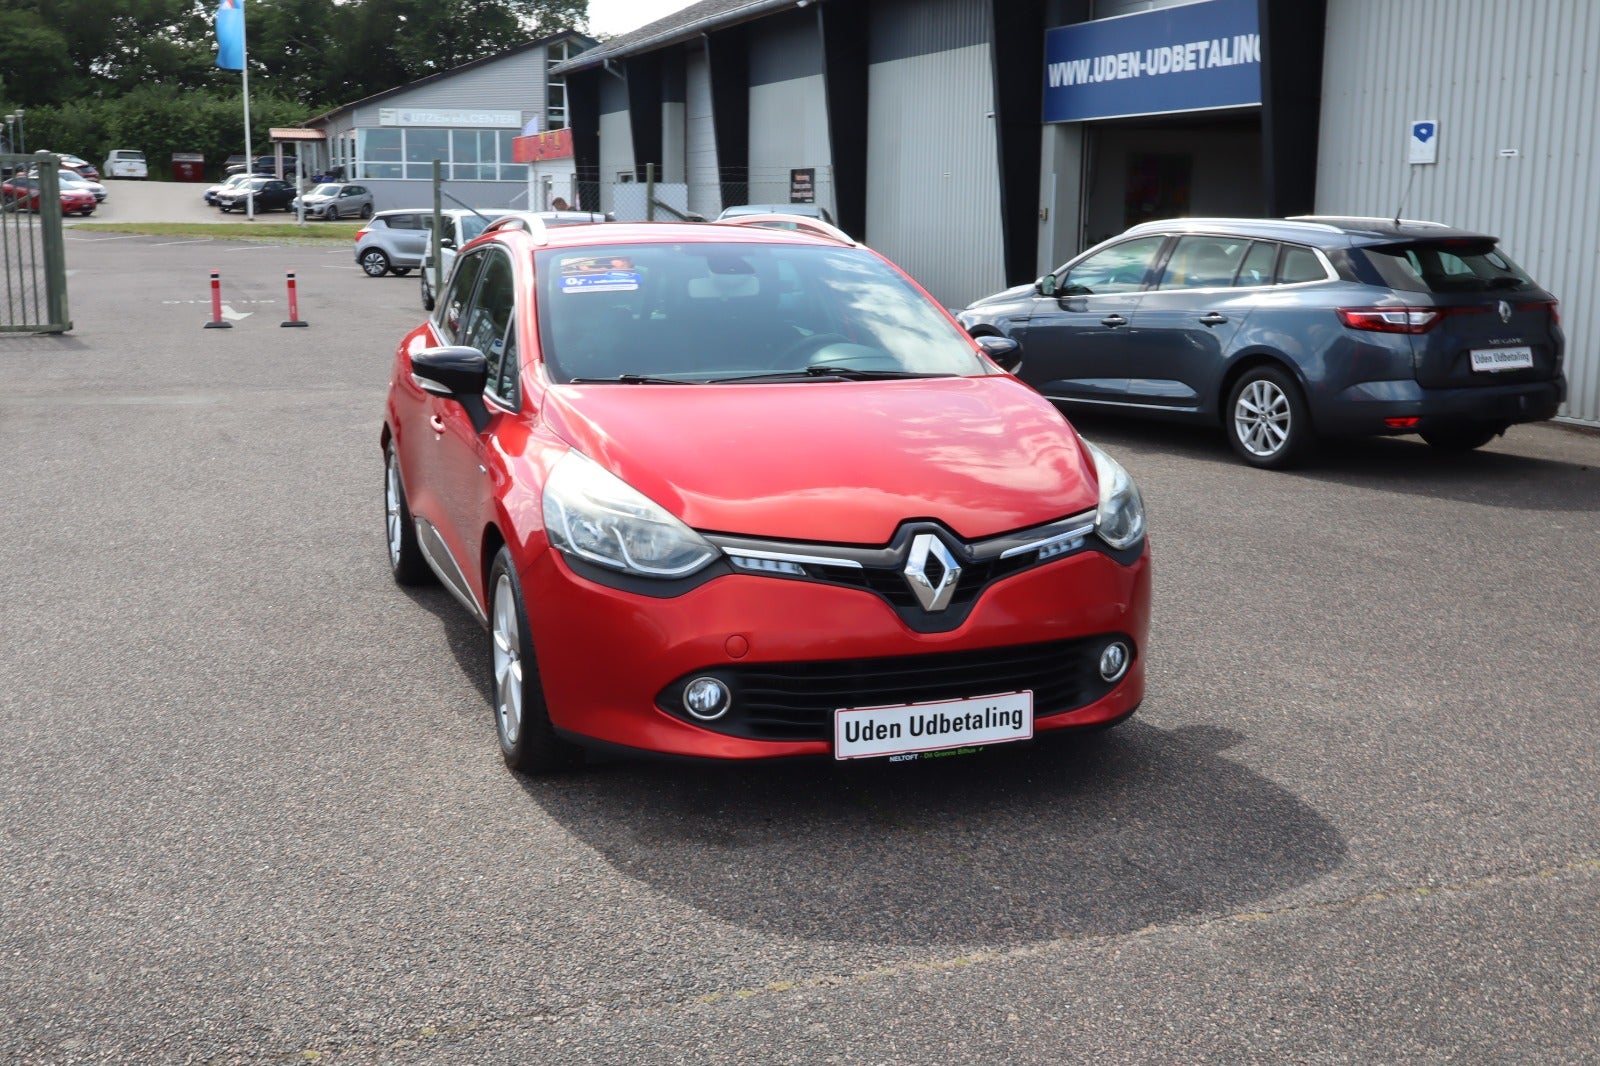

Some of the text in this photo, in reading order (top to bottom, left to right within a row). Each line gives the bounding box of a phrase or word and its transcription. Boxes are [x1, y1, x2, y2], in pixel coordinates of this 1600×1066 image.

[1474, 352, 1493, 364] Uden
[845, 706, 1023, 743] Uden Udbetaling
[889, 753, 919, 763] NELTOFT
